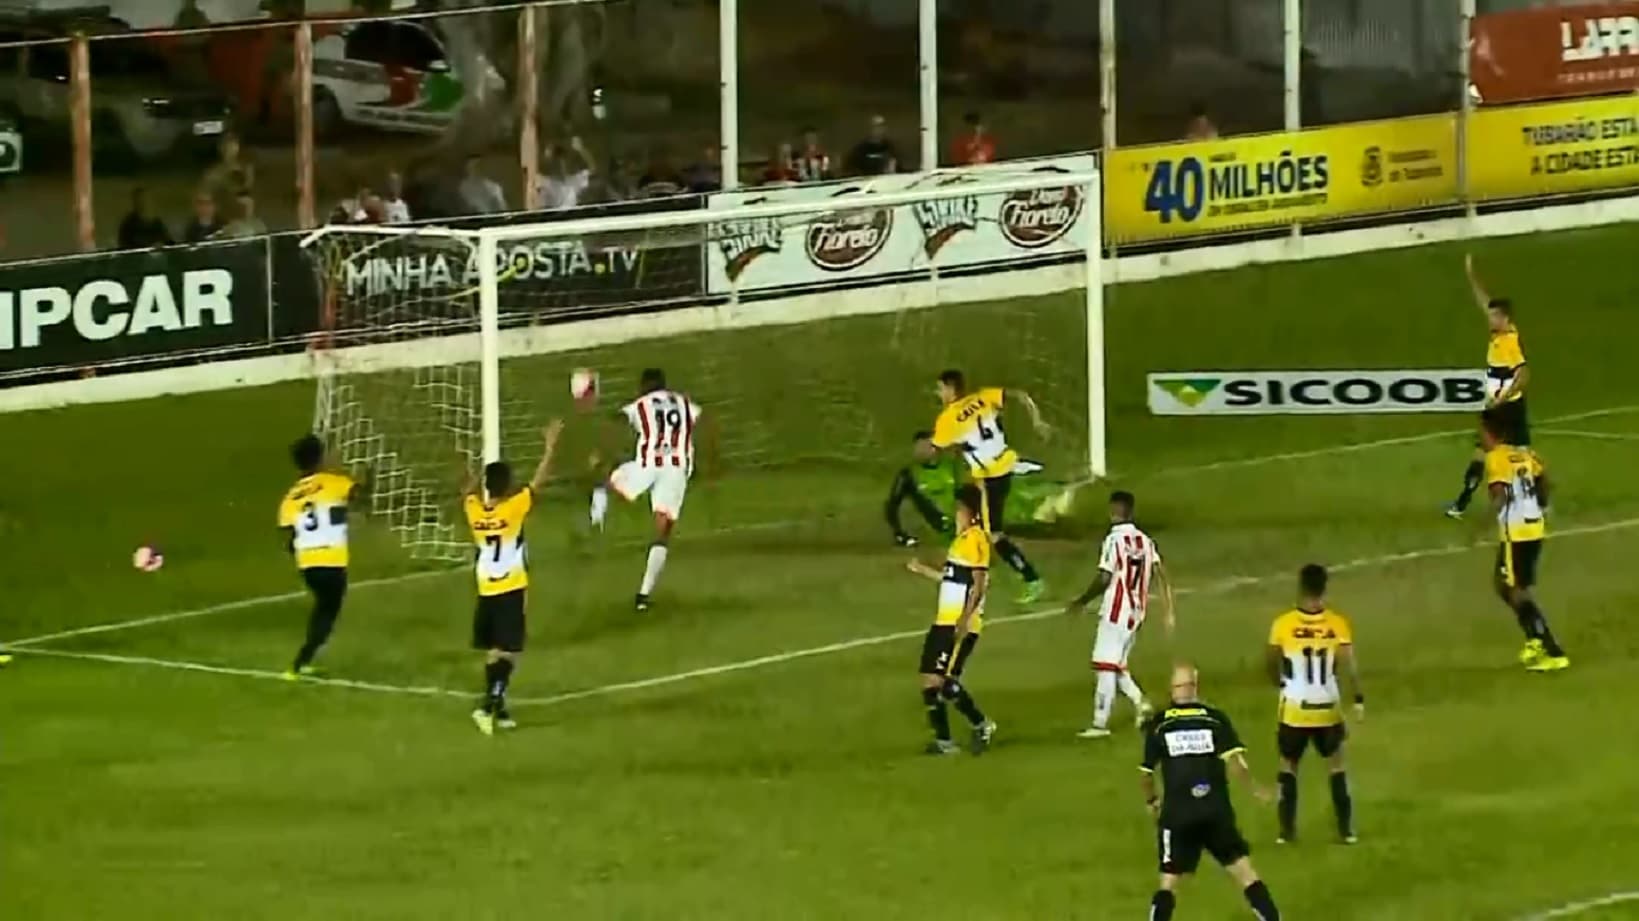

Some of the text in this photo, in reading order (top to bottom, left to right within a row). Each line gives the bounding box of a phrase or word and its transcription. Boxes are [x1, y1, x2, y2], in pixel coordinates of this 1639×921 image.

[1144, 156, 1204, 224] 40
[1209, 151, 1328, 200] MILHÕES
[346, 252, 450, 296] MINHA
[1224, 378, 1486, 405] SICOOB
[655, 409, 682, 436] 19
[303, 501, 319, 532] 3
[485, 534, 502, 563] 7
[1302, 646, 1328, 685] 11
